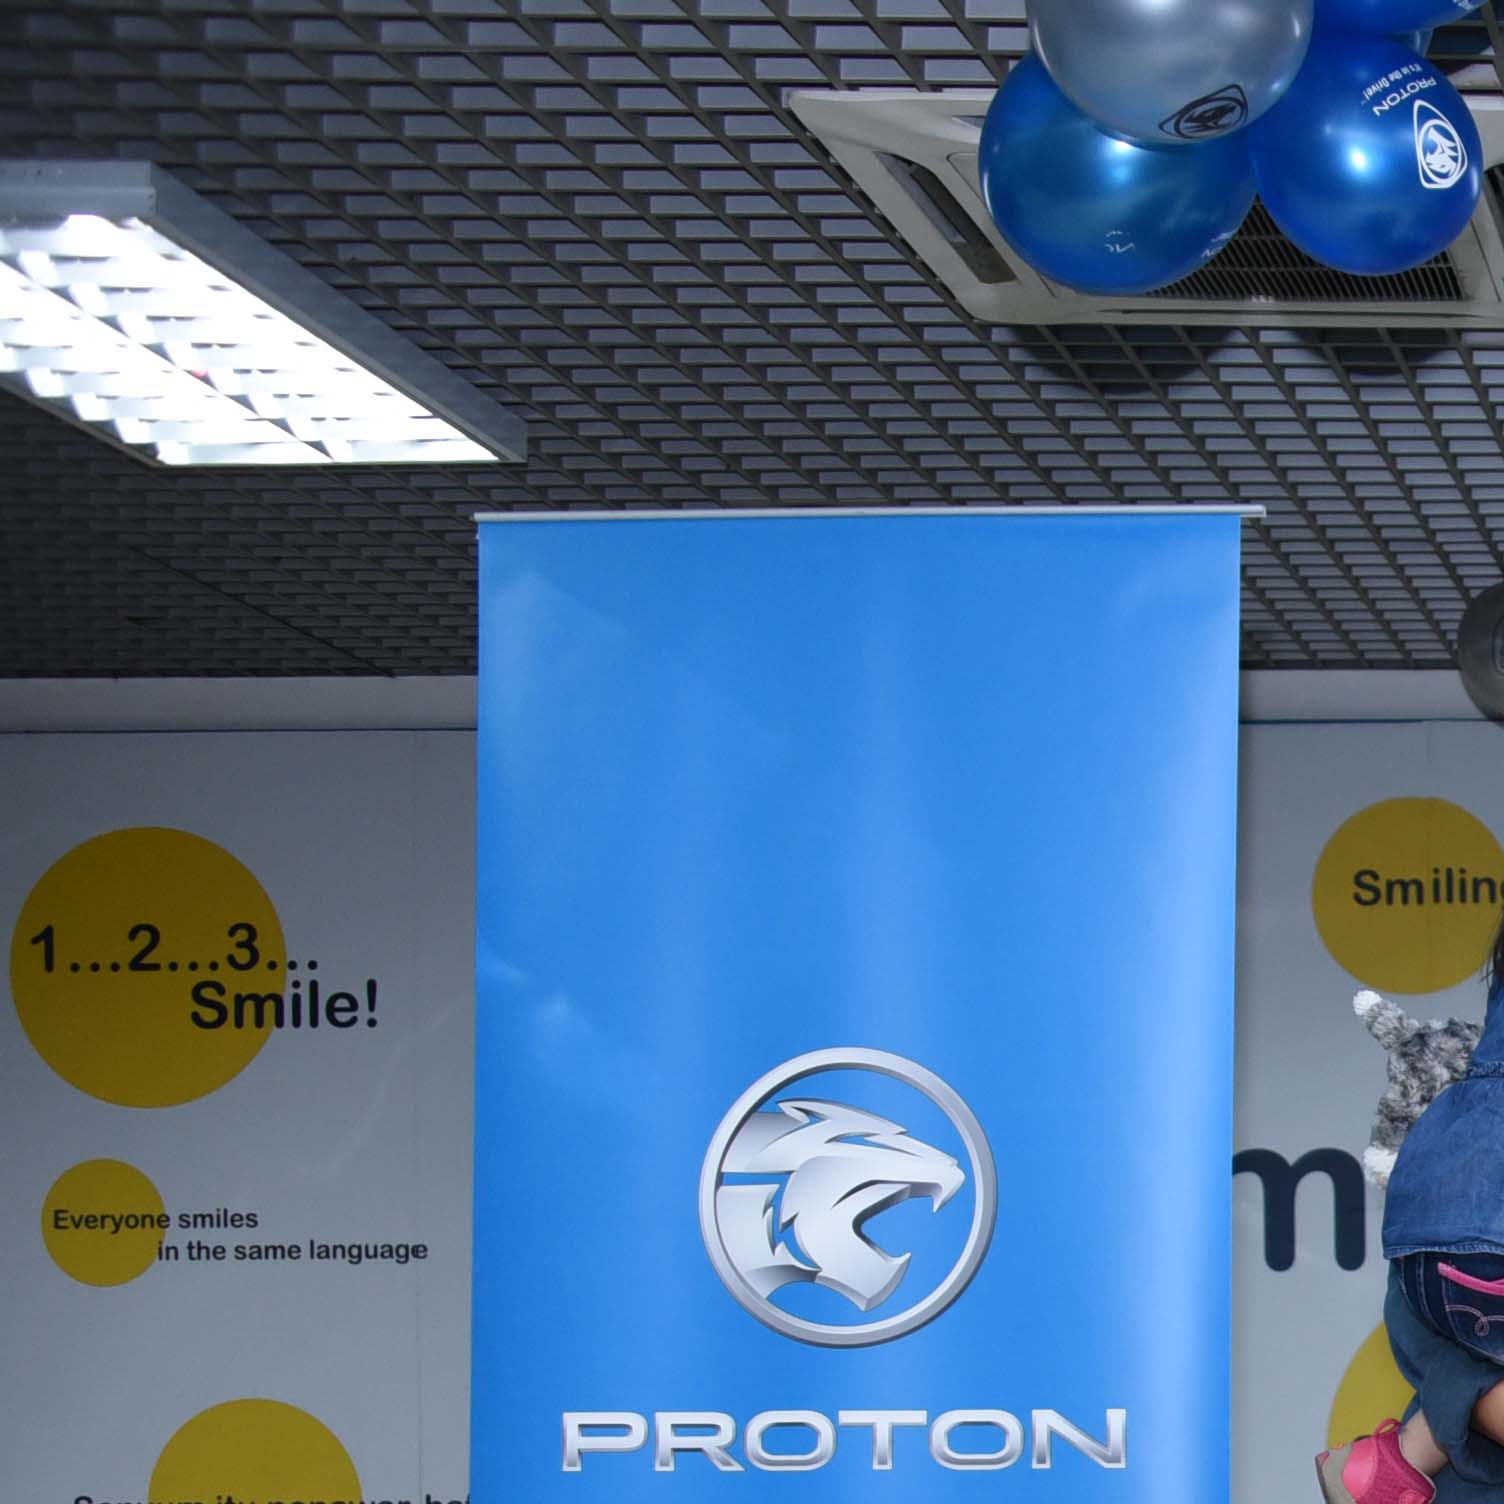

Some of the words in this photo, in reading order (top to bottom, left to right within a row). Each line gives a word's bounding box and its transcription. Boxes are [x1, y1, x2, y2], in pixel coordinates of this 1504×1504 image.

[1372, 76, 1438, 117] PROTON
[190, 979, 378, 1030] Smile!
[53, 1208, 171, 1234] Everyone
[178, 1208, 258, 1229] smiles
[158, 1241, 178, 1261] in
[187, 1241, 226, 1261] the
[234, 1244, 301, 1261] same
[309, 1239, 428, 1265] language
[561, 1407, 1127, 1472] PROTON
